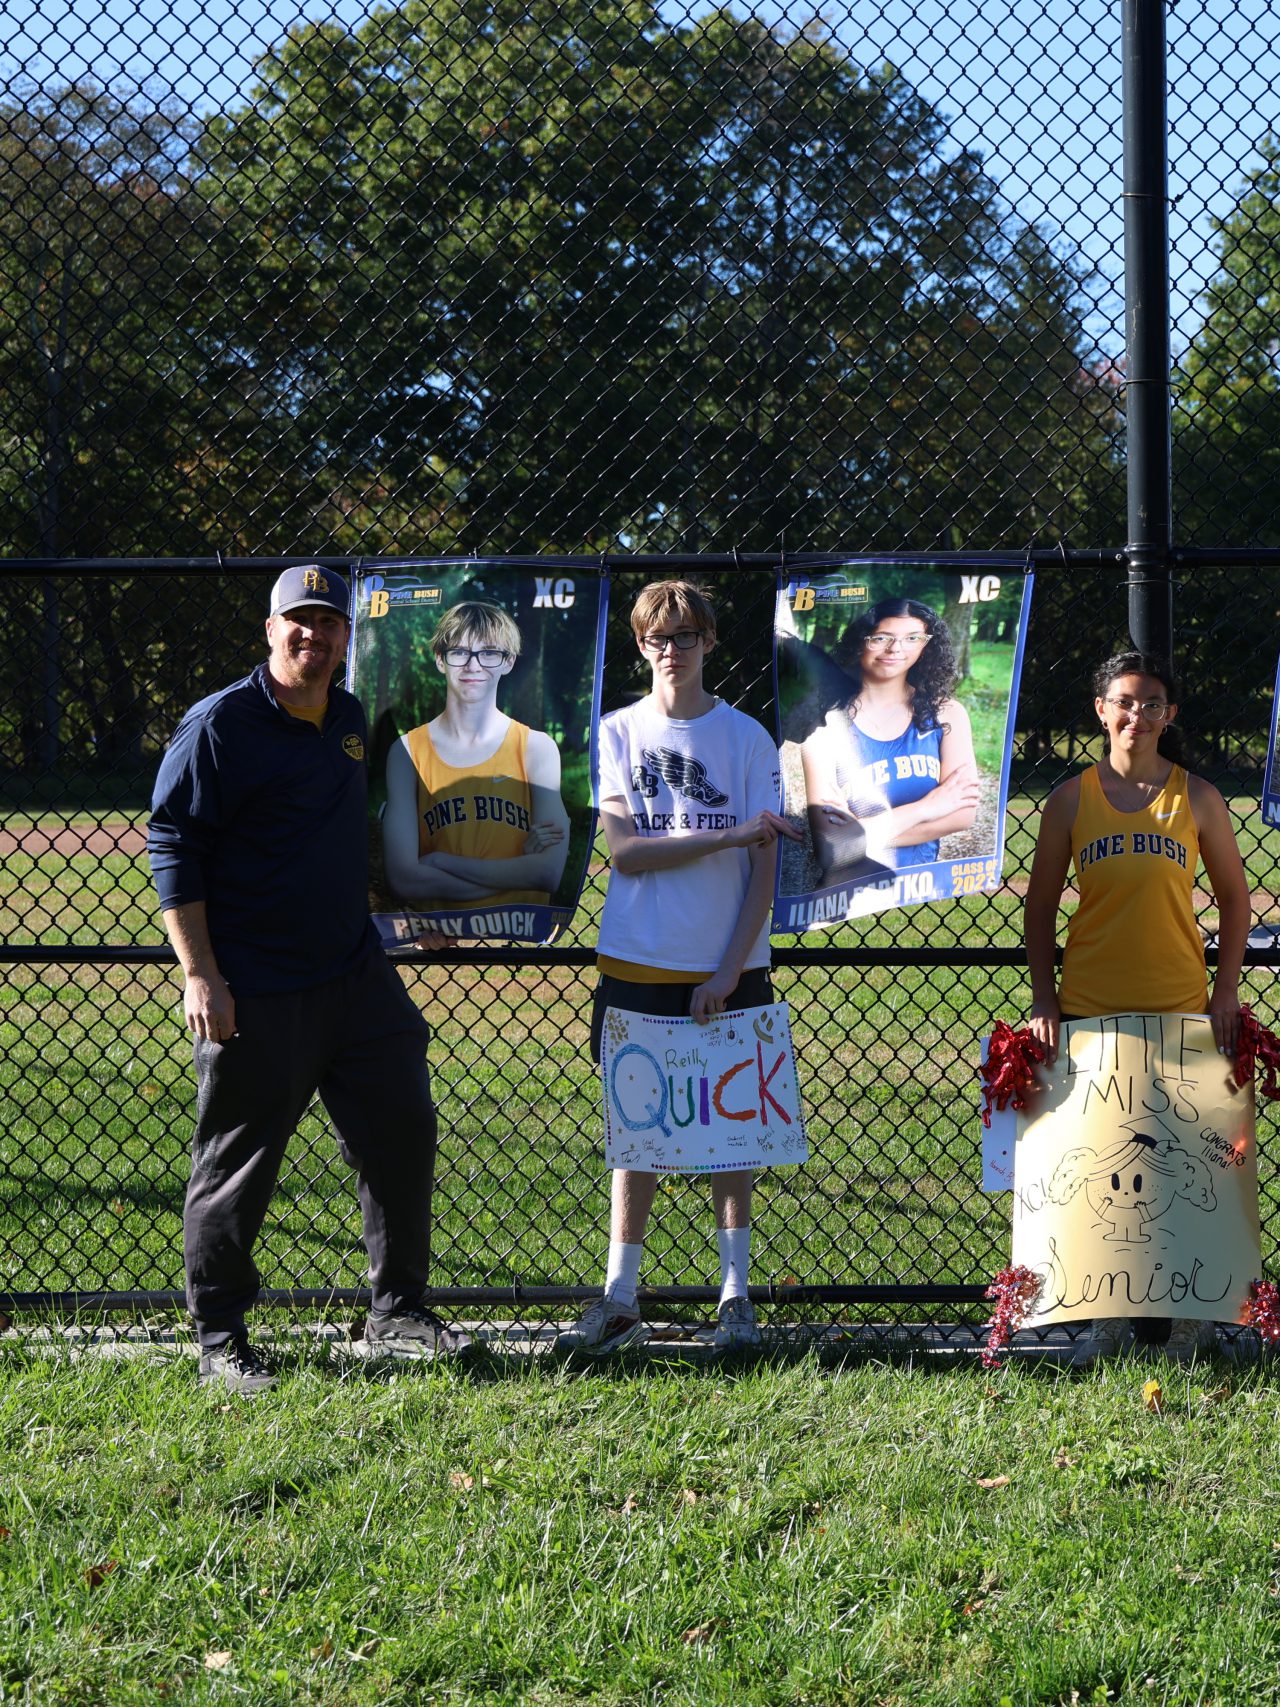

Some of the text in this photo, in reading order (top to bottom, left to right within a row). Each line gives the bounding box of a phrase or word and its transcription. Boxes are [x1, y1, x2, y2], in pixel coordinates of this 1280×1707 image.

[414, 589, 439, 599] BUSH
[532, 577, 576, 609] XC
[840, 587, 865, 597] BUSH
[958, 575, 1001, 604] XC
[424, 795, 531, 836] PINE BUSH
[680, 813, 692, 830] &
[951, 861, 984, 877] CLASS
[1079, 833, 1188, 873] PINE BUSH
[469, 911, 536, 937] QUICK
[788, 890, 847, 927] ILIANA
[665, 1048, 709, 1077] Reilly
[1066, 1015, 1206, 1083] LITTLE
[610, 1039, 792, 1138] QUICK
[1083, 1075, 1199, 1123] MISS
[1199, 1126, 1247, 1167] CONGRATS
[1034, 1237, 1232, 1315] Senior
